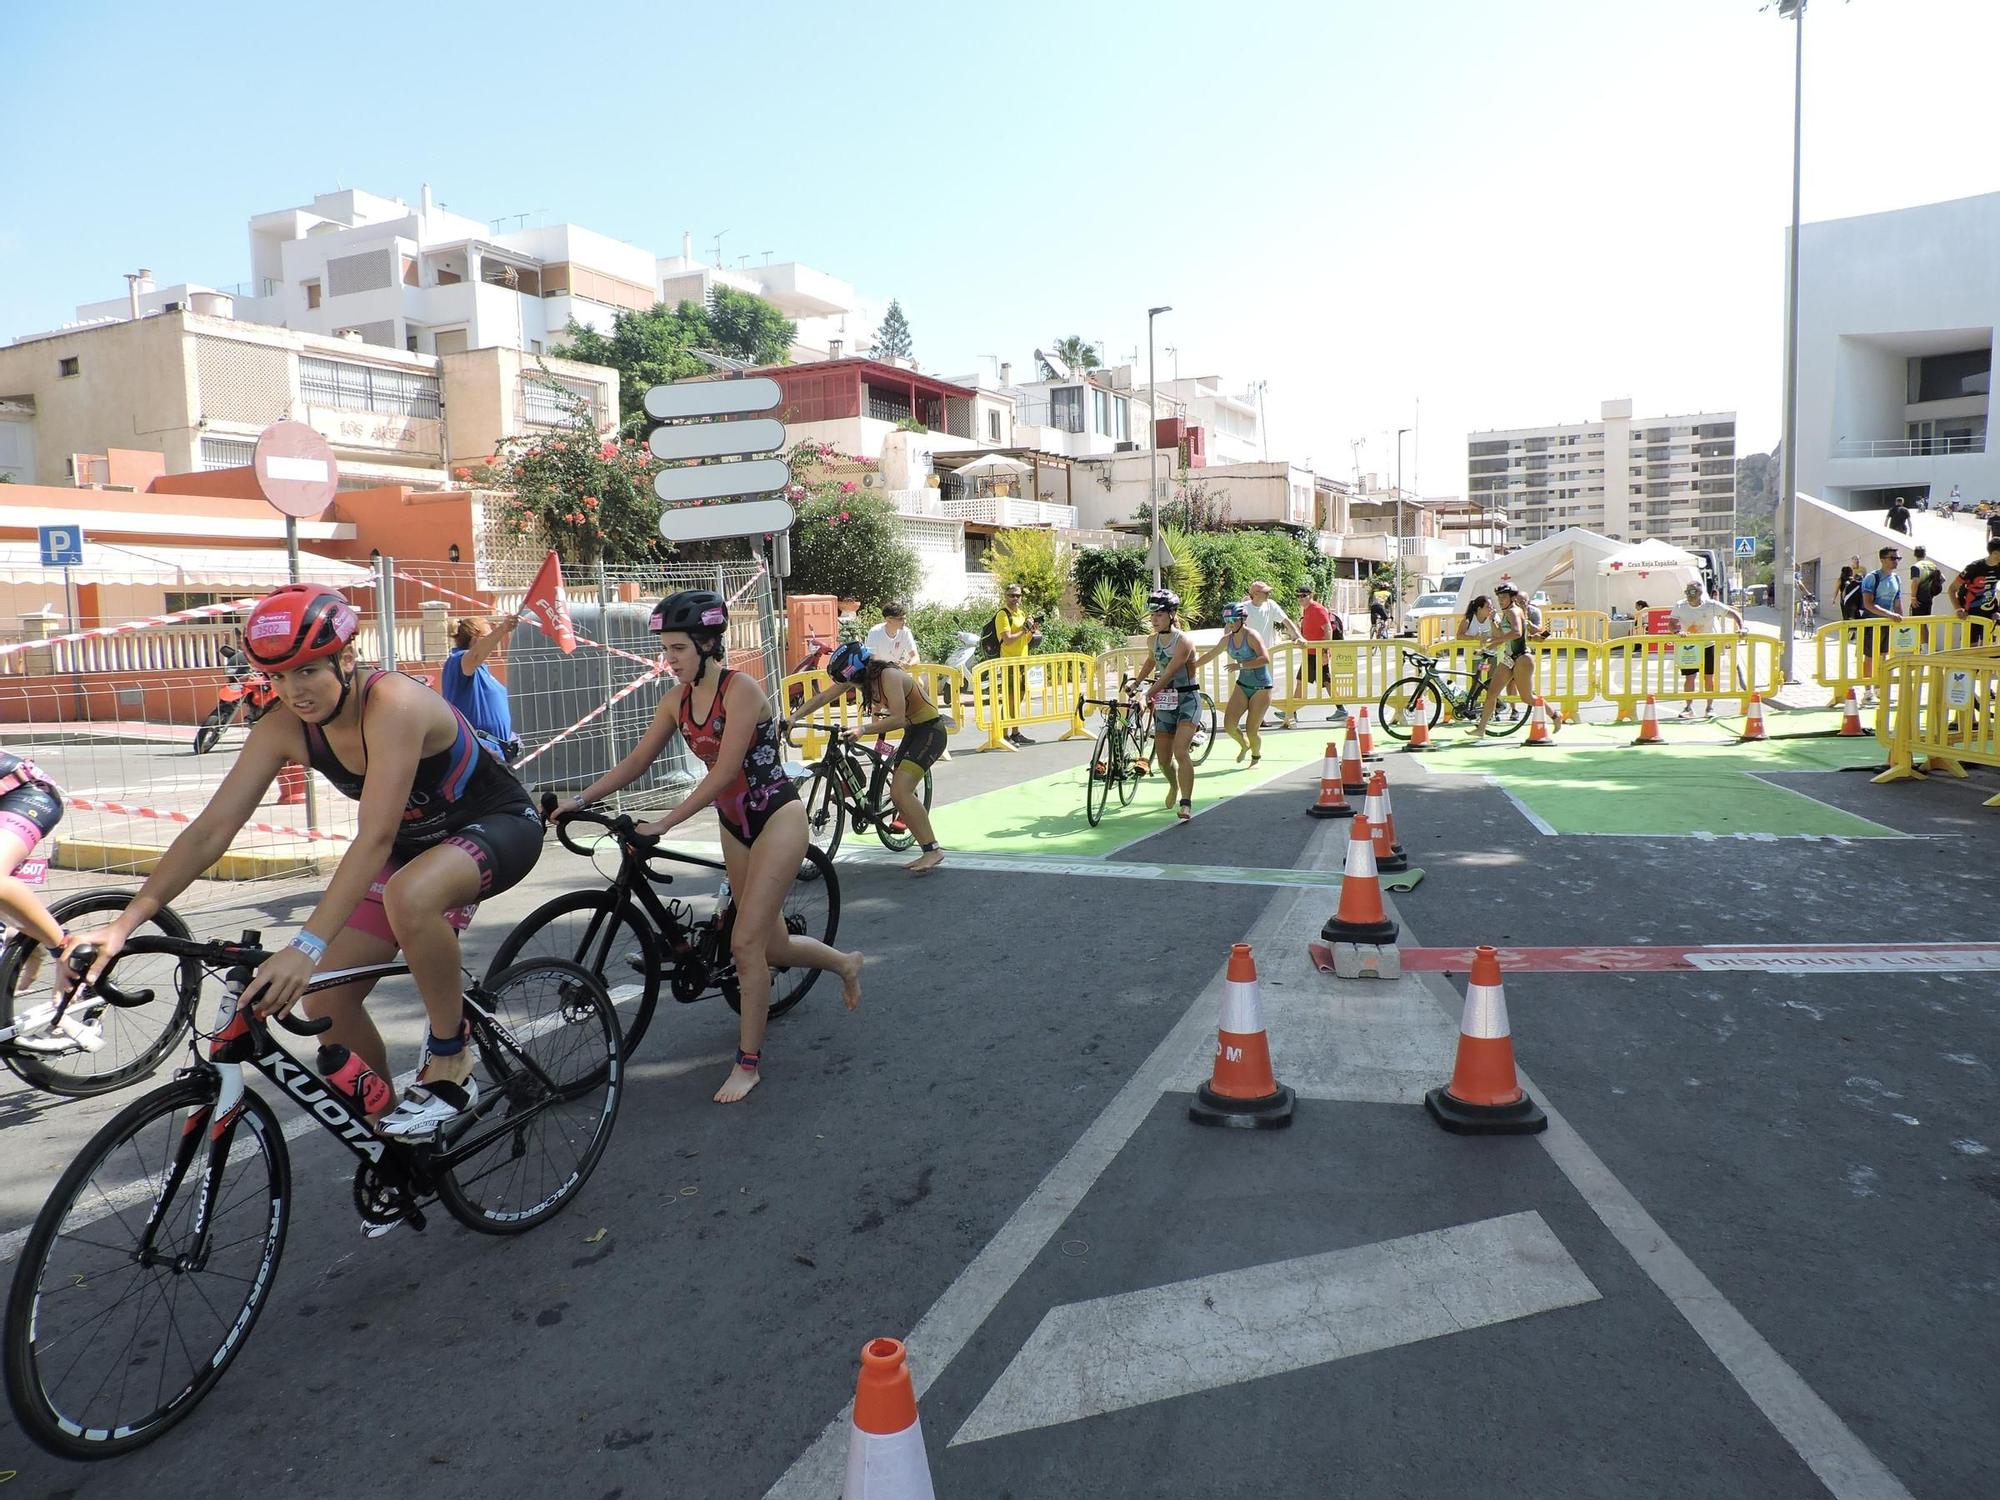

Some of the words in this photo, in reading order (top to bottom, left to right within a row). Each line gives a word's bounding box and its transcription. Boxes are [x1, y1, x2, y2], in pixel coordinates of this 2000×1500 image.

[340, 420, 364, 438] LOS
[49, 530, 71, 561] P
[1642, 560, 1654, 568] Roja
[1654, 559, 1678, 568] Española
[838, 758, 871, 810] REK
[1705, 957, 1873, 966] DISMOUNT
[1880, 956, 1961, 965] LINE
[489, 1021, 523, 1054] KUOTA
[258, 1051, 386, 1164] KUOTA
[194, 1167, 213, 1234] KUOTA
[484, 1171, 579, 1221] PROGRESS
[213, 1198, 281, 1369] PROGRESS
